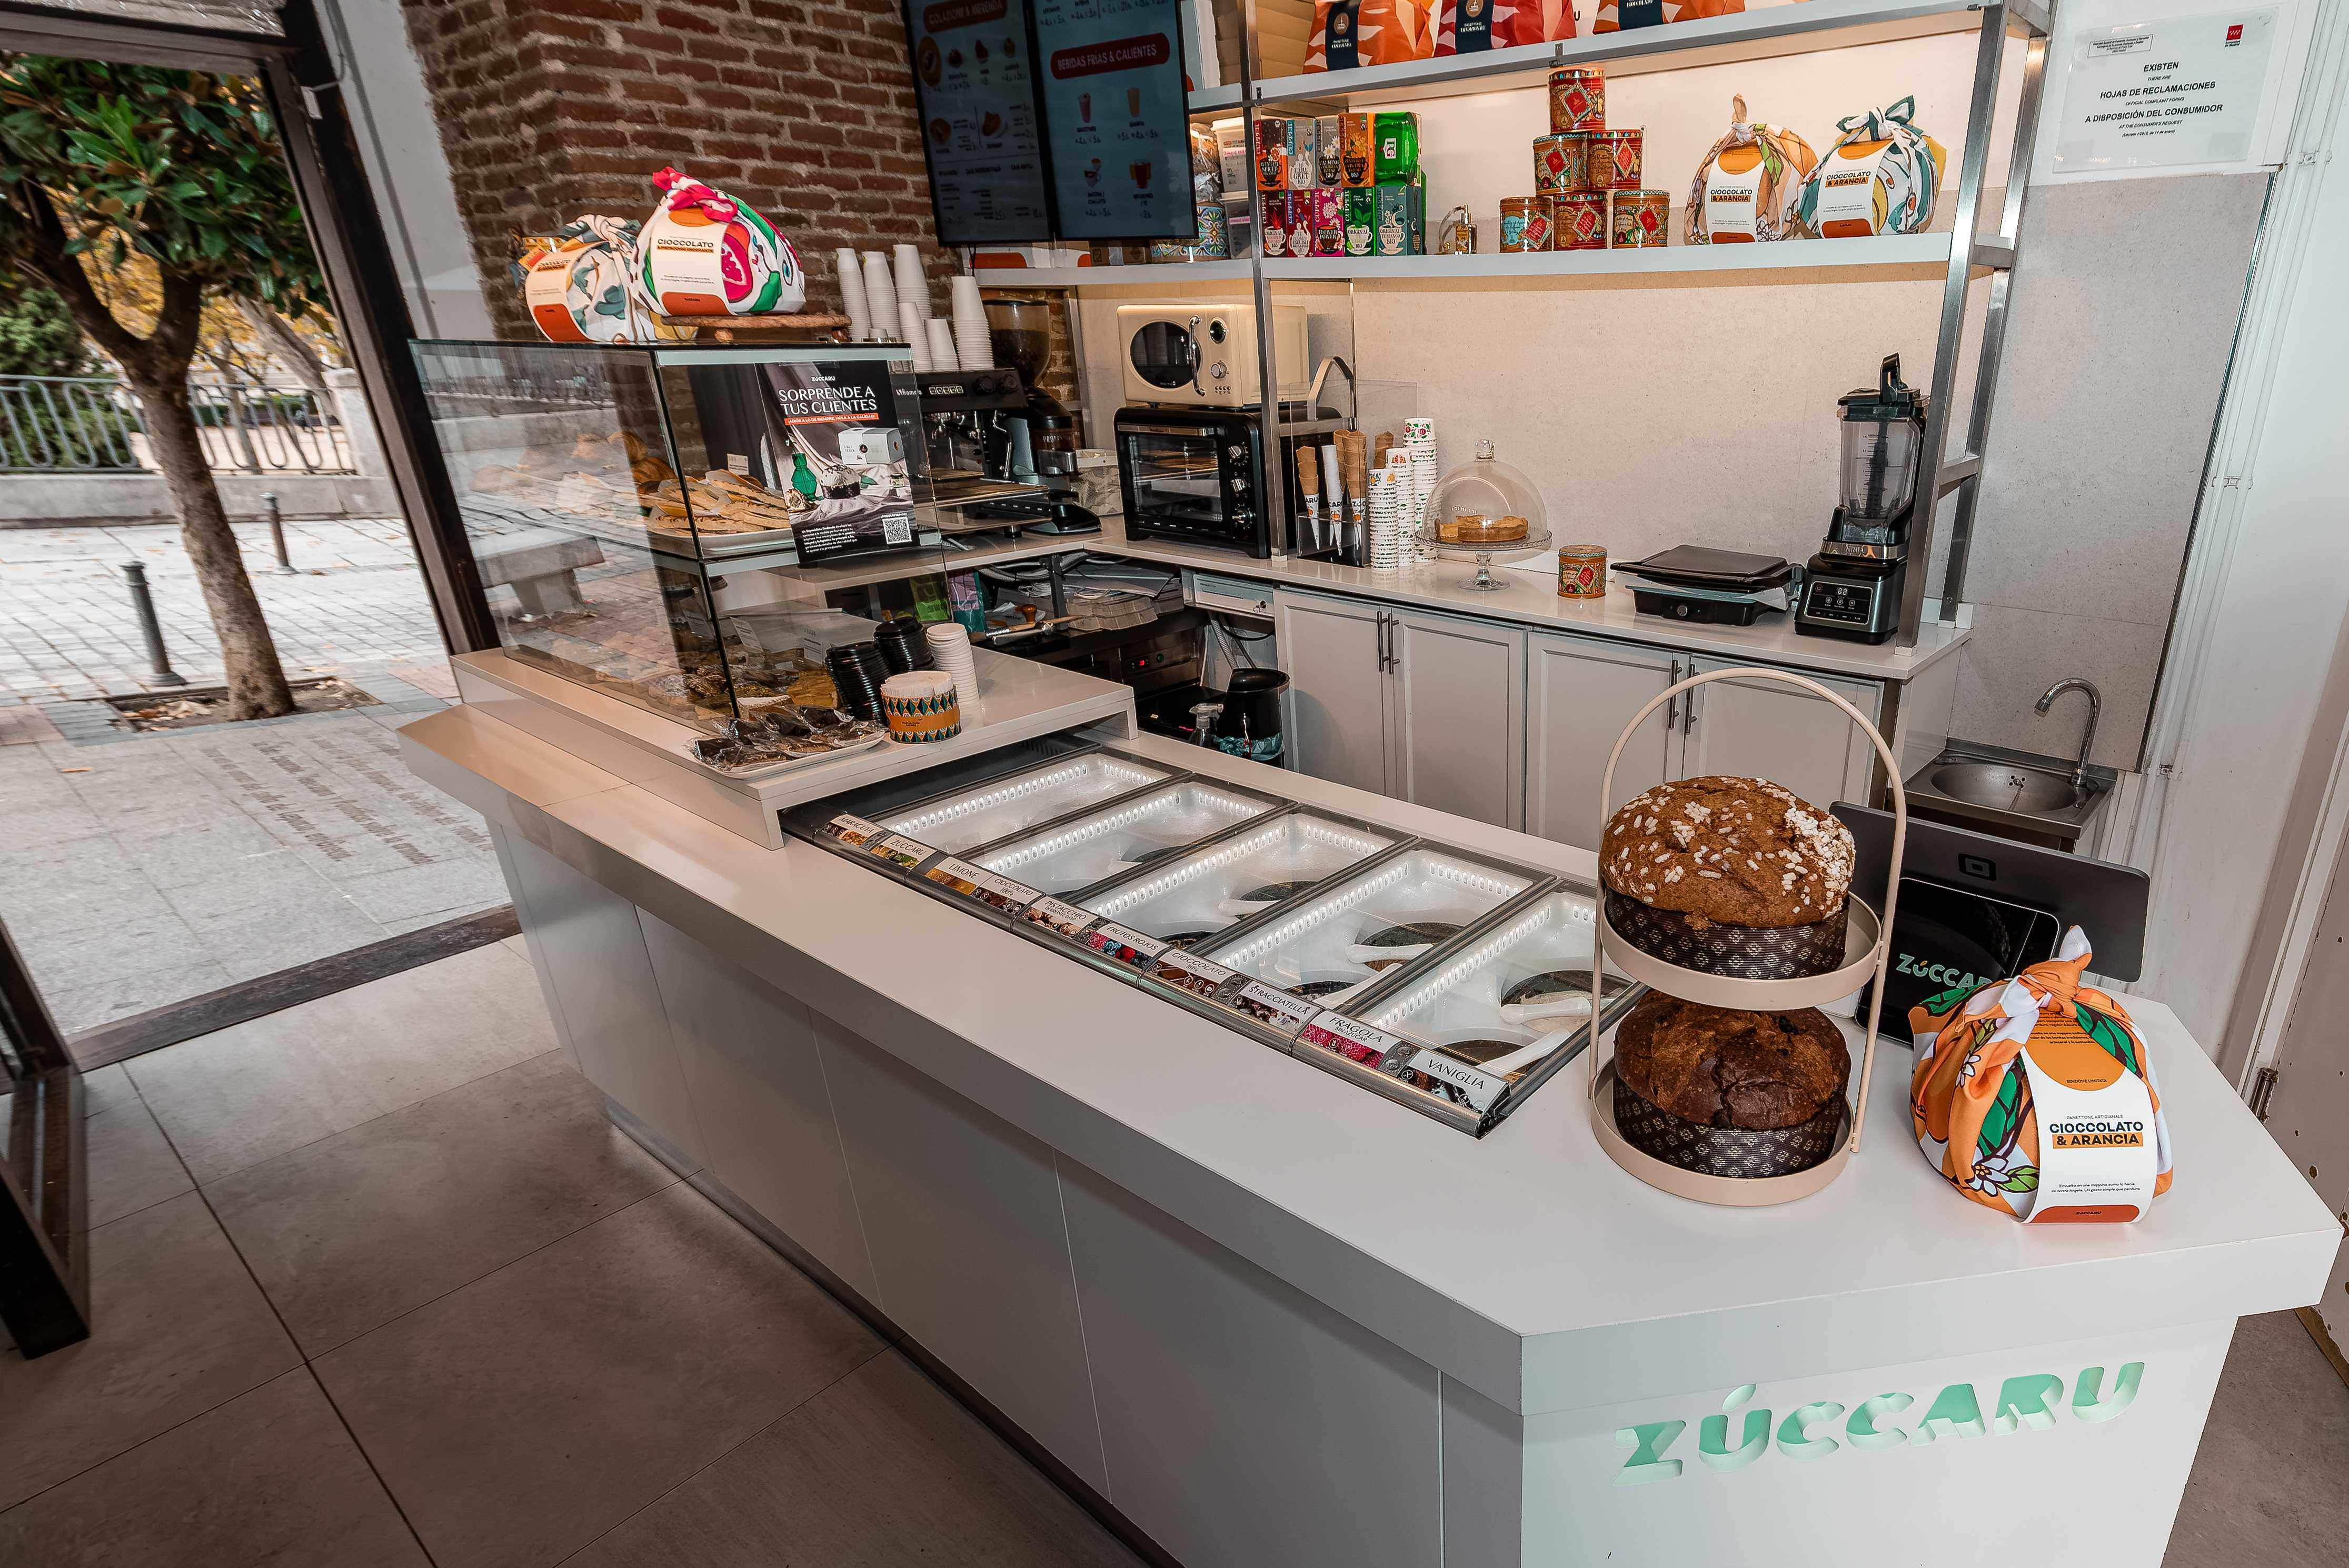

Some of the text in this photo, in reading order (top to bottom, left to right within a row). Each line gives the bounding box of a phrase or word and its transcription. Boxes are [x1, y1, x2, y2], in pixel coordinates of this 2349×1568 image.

[1058, 55, 1086, 70] BEBIDAS
[1116, 44, 1157, 61] CALIENTES
[2143, 62, 2179, 72] EXISTEN
[2100, 89, 2127, 99] HOJAS
[2142, 81, 2216, 95] RECLAMACIONES
[2093, 109, 2145, 122] DISPOSICIÓN
[2165, 104, 2223, 116] CONSUMIDOR
[1826, 171, 1871, 180] CIOCCOLATO
[658, 239, 714, 248] CIOCCOLATO
[779, 385, 875, 402] SORPRENDE A
[780, 398, 878, 415] TUS CLIENTES
[949, 863, 980, 880] LIMONE
[994, 878, 1033, 896] CIOCCOLATO
[1000, 887, 1014, 896] 100%
[1045, 901, 1087, 920] PISTACCHIO
[1107, 926, 1159, 951] FRUTOS ROJOS
[1171, 952, 1226, 976] CIOCCOLATO
[1248, 985, 1311, 1015] STRACCIATELLA
[1329, 1017, 1383, 1043] FRAGOLA
[1428, 1058, 1485, 1090] VANIGLIA
[2049, 1121, 2144, 1133] CIOCCOLATO
[2056, 1134, 2139, 1145] & ARANCIA
[1613, 1361, 2146, 1487] ZÚCCARU
